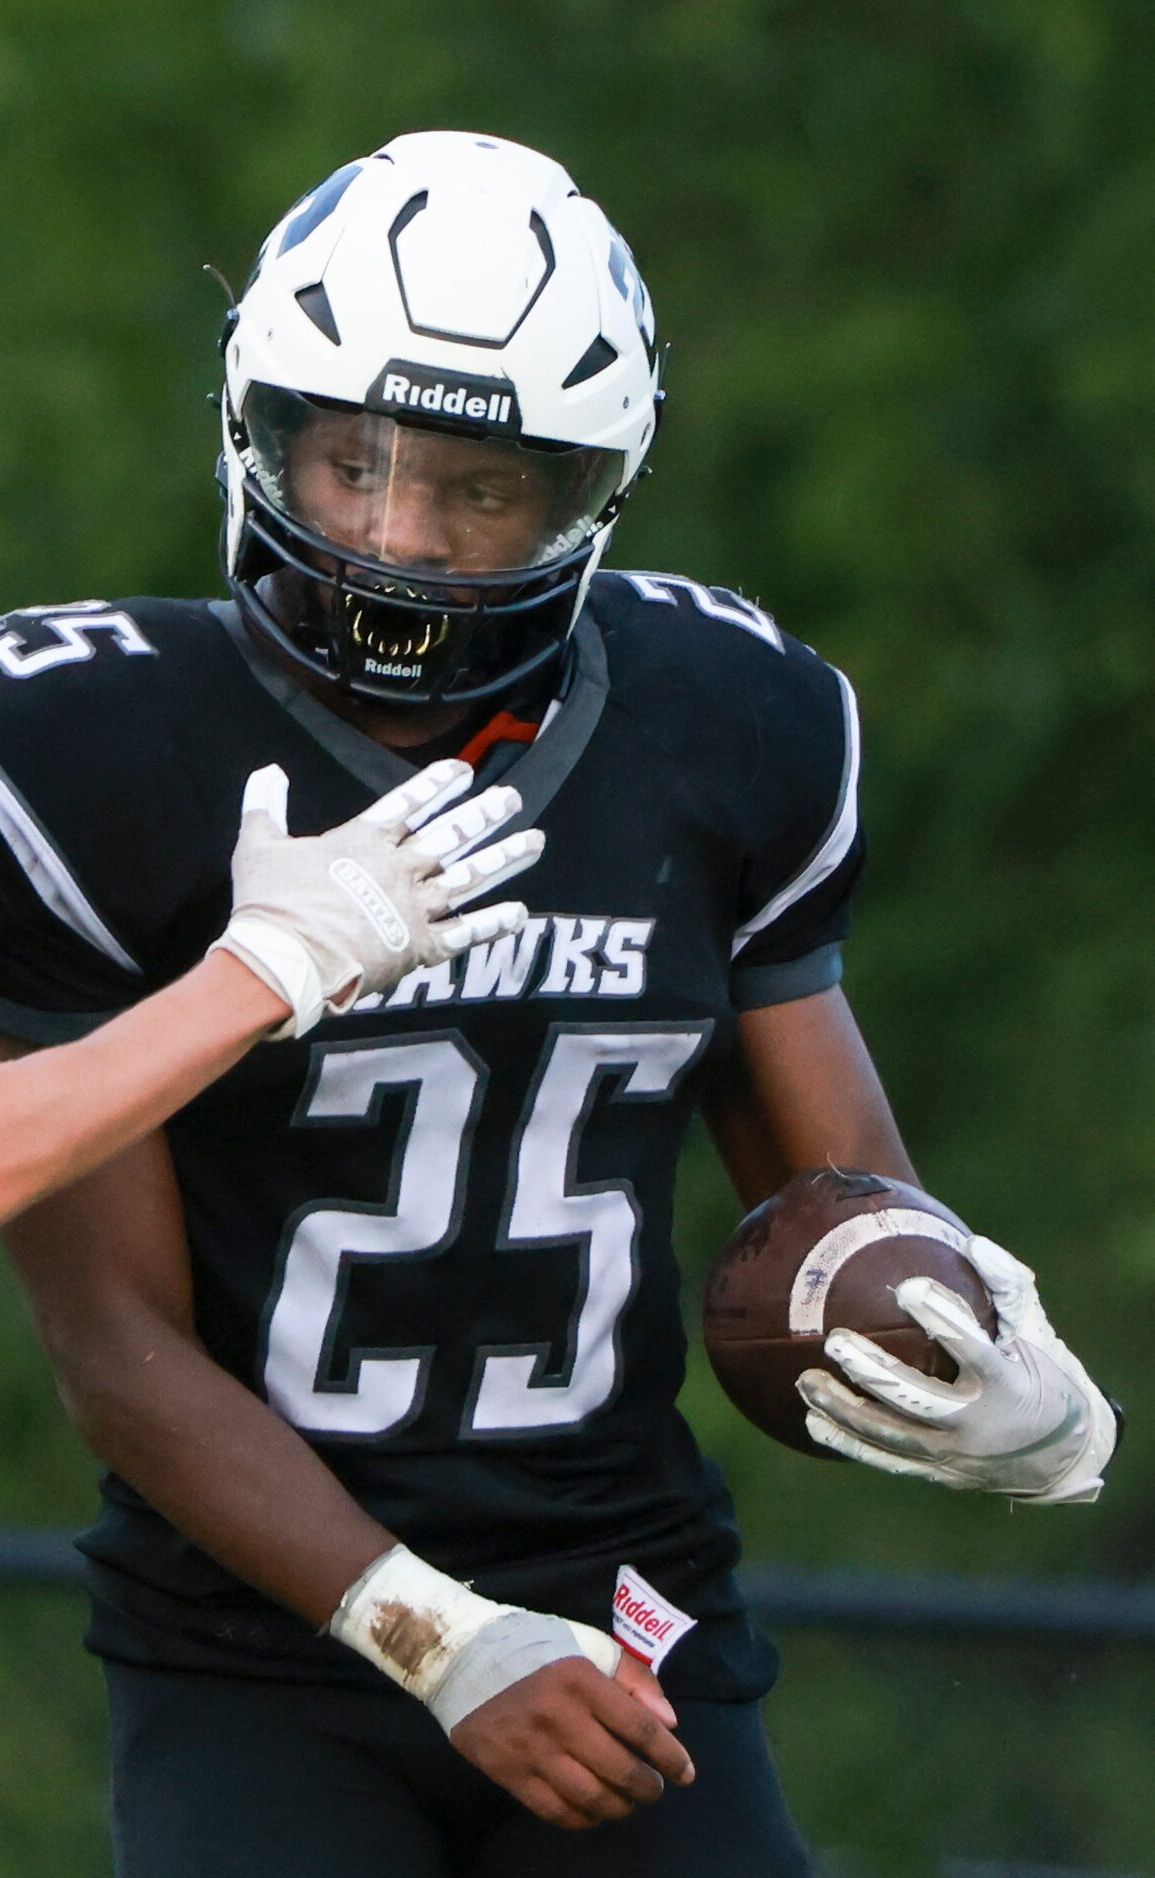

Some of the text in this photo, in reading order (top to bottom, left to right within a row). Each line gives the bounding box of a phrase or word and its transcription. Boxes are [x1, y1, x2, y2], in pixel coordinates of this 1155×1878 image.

[382, 365, 512, 423] Riddell
[364, 657, 422, 678] Riddell
[352, 917, 655, 1010] AWKS
[262, 1018, 714, 1442] 25
[614, 1584, 675, 1641] Riddell
